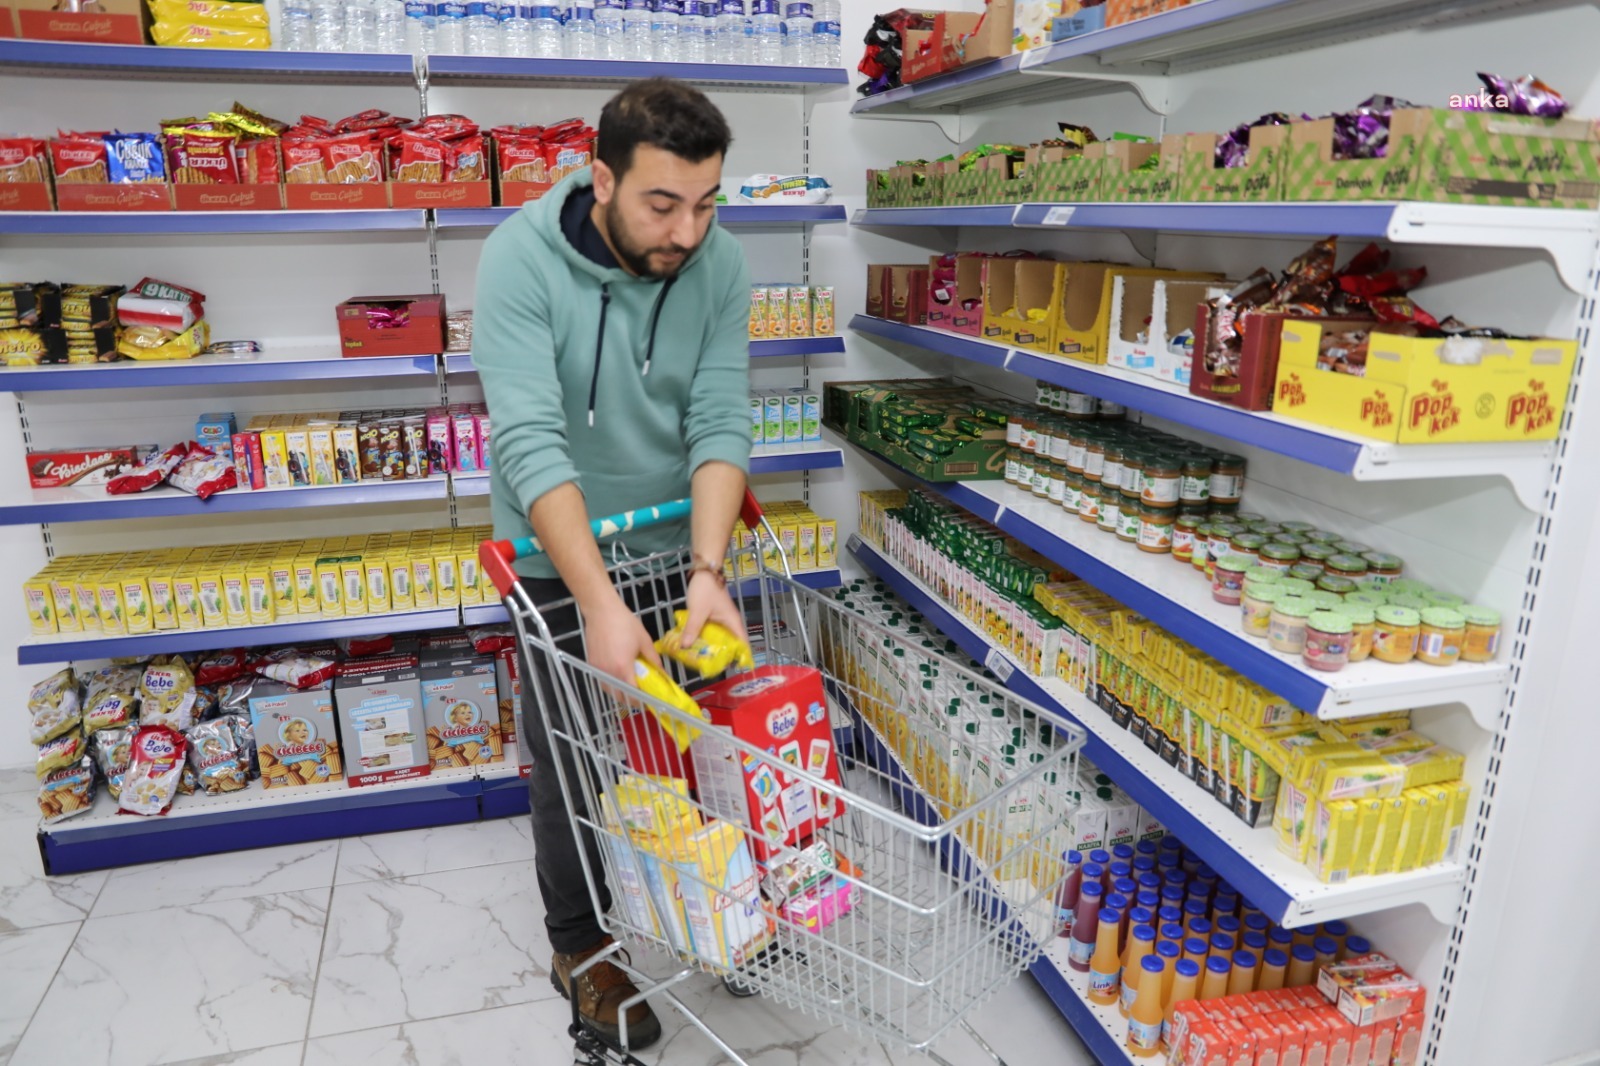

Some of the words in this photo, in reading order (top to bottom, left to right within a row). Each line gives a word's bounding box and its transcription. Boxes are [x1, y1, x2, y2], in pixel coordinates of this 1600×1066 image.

[144, 283, 159, 297] 9
[158, 285, 180, 301] KAT
[1279, 380, 1303, 401] Pop
[1361, 398, 1389, 421] Pop
[1373, 413, 1393, 427] kek
[1409, 393, 1454, 430] Pop
[1505, 393, 1550, 429] Pop
[1429, 408, 1461, 437] kek
[1524, 407, 1556, 435] kek
[145, 676, 174, 687] Bebe
[772, 715, 795, 735] Bebe
